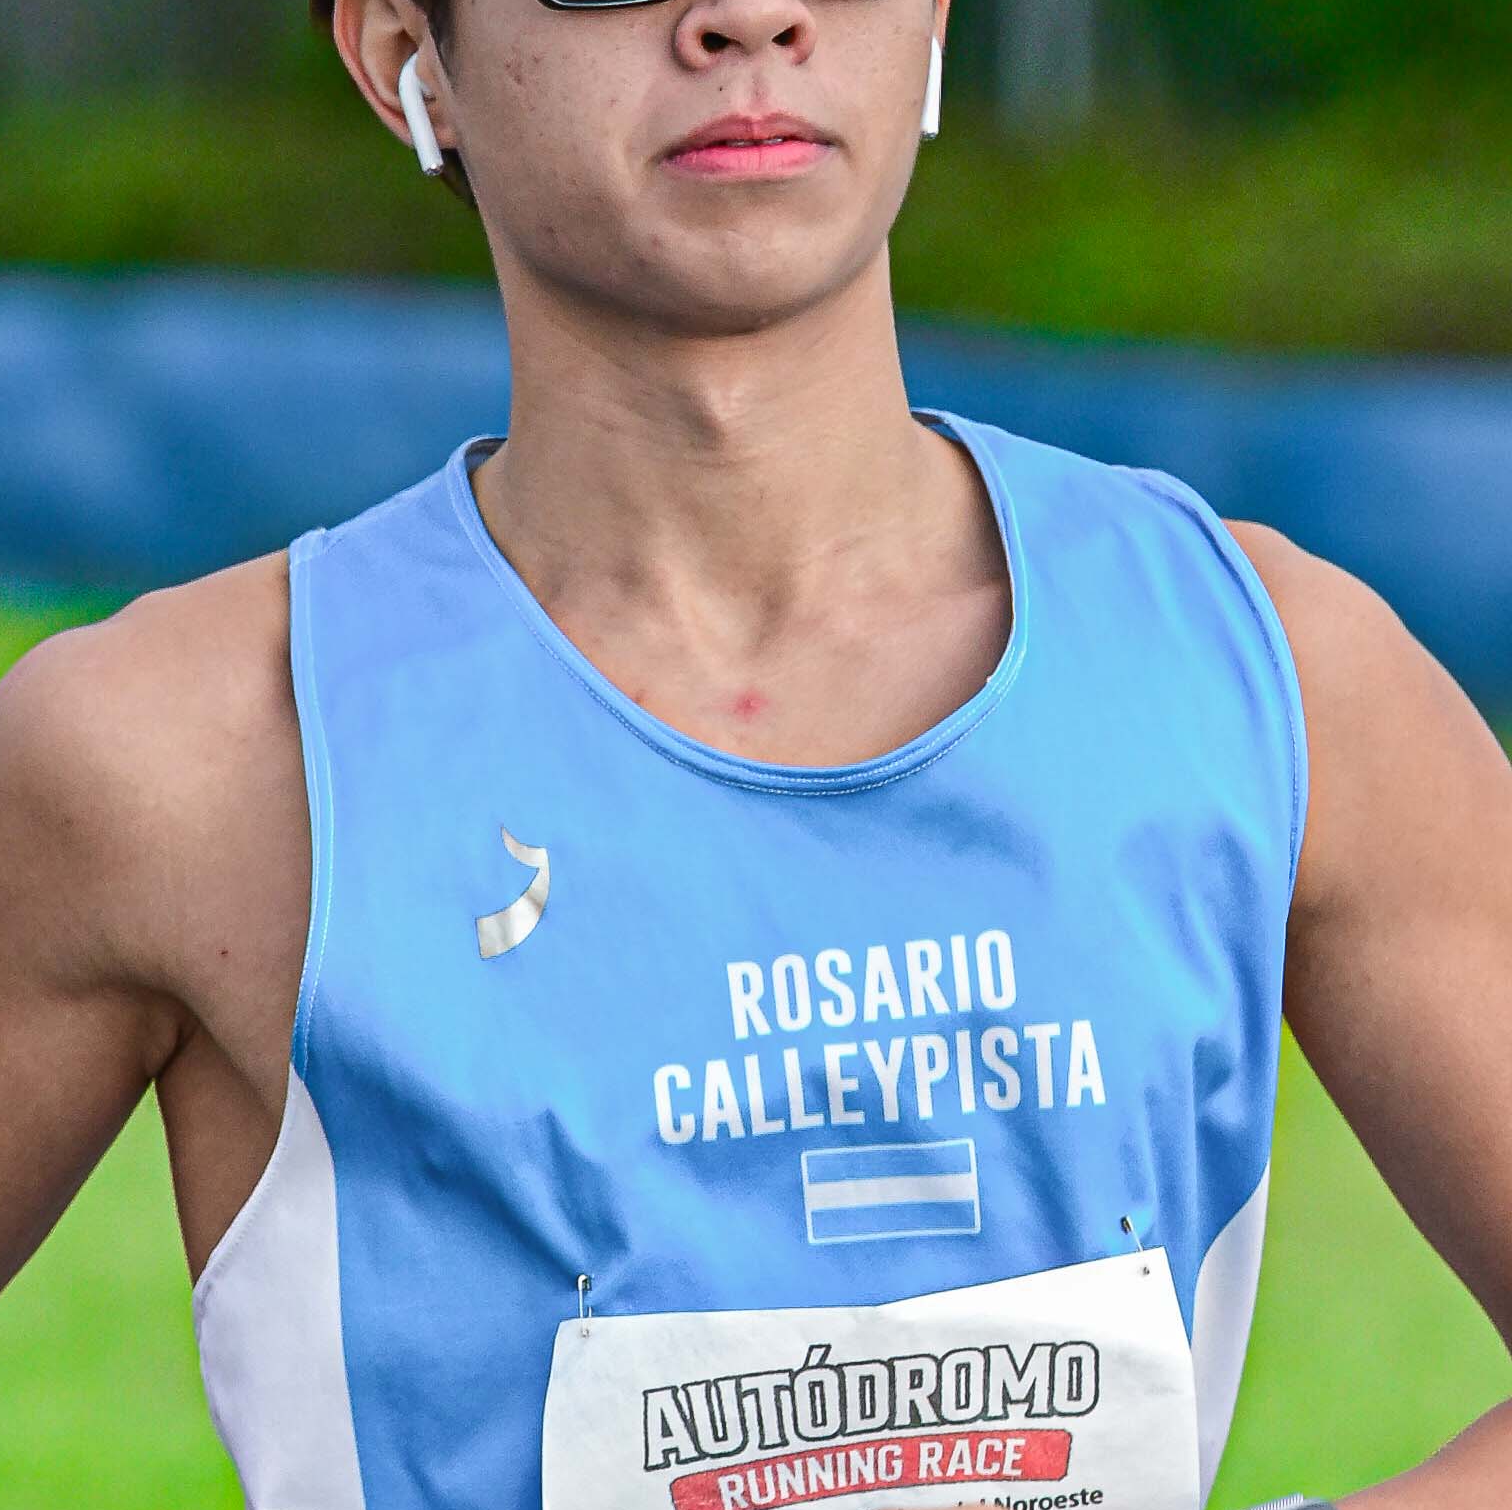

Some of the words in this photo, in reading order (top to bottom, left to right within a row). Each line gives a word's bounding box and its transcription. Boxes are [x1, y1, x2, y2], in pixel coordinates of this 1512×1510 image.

[726, 929, 1017, 1039] ROSARIO
[653, 1019, 1107, 1145] CALLEYPISTA
[643, 1341, 1100, 1471] AUTÓDROMO
[918, 1436, 1026, 1478] RACE
